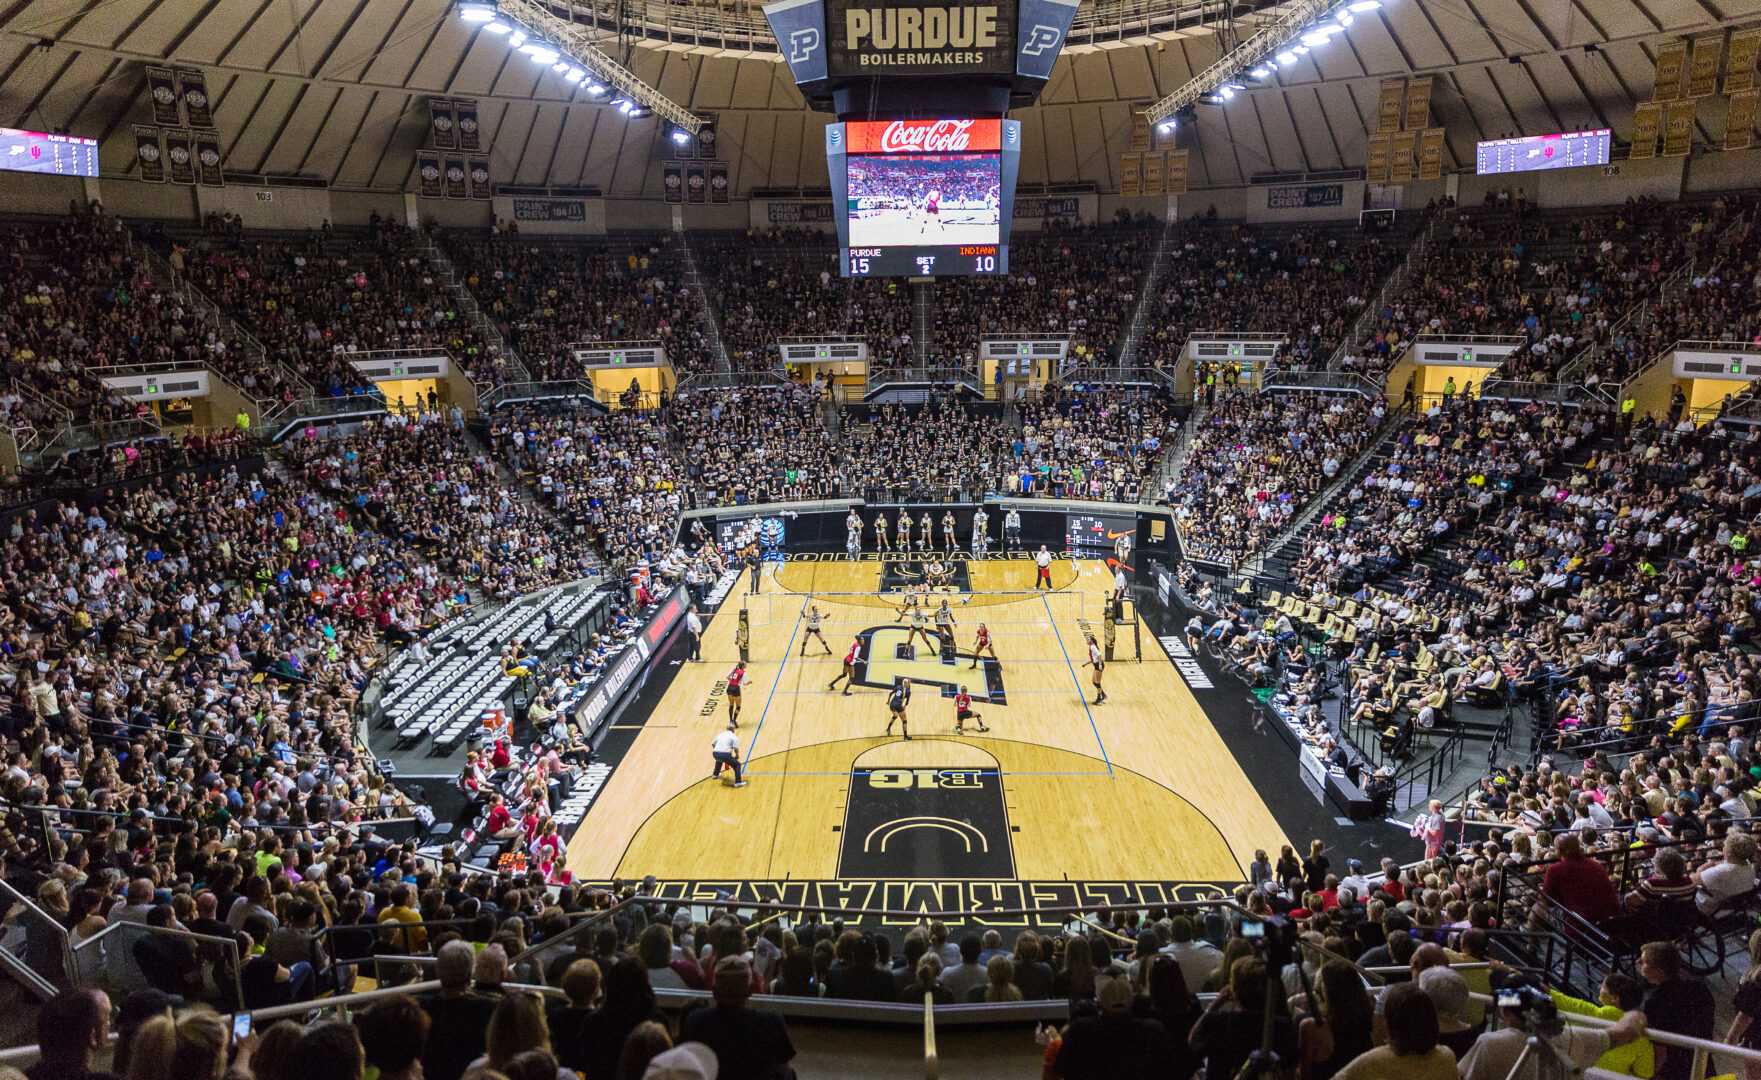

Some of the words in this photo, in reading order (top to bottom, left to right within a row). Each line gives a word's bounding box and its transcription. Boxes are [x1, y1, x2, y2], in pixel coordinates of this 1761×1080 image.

[846, 7, 997, 49] PURDUE
[860, 52, 984, 65] BOILERMAKERS
[881, 119, 975, 152] Coca-Cola
[1603, 166, 1620, 176] 108
[255, 191, 272, 201] 103
[1270, 187, 1307, 198] PAINT
[515, 201, 551, 210] PAINT
[1270, 197, 1305, 207] CREW
[515, 209, 550, 219] CREW
[850, 249, 881, 257] PURDUE
[960, 247, 996, 256] INDIANA
[917, 257, 935, 265] SET
[976, 257, 994, 272] 10
[851, 259, 869, 274] 15
[922, 265, 930, 274] 2
